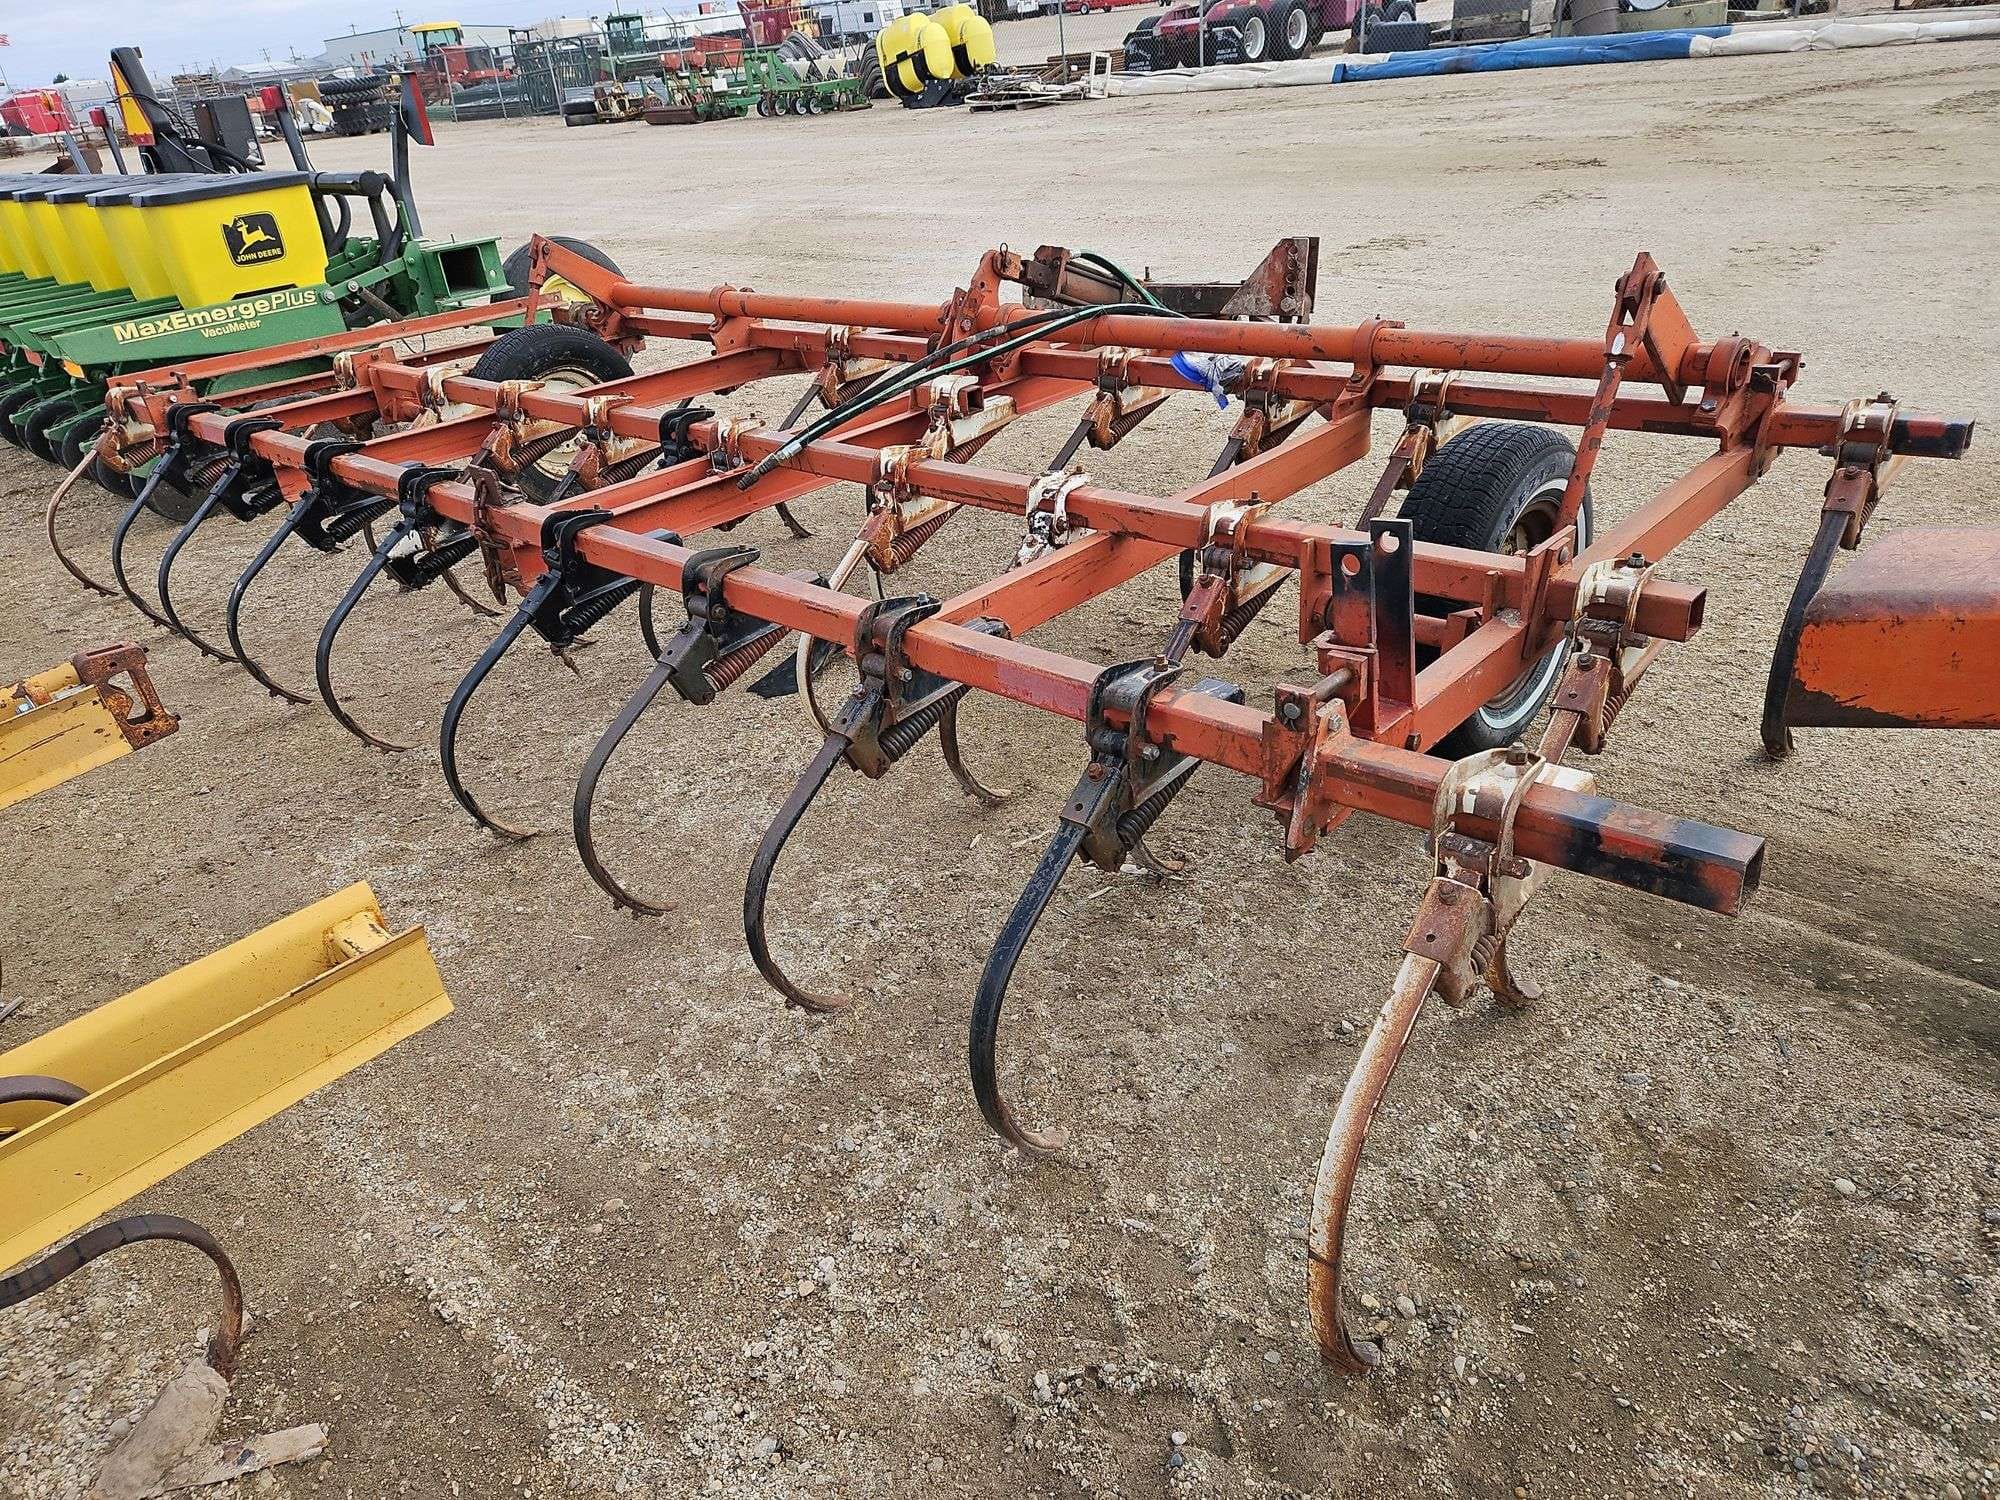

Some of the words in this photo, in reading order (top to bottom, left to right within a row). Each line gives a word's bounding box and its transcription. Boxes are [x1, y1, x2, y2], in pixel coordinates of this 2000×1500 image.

[236, 252, 257, 262] JOHN
[257, 247, 282, 258] DEERE
[201, 319, 262, 338] VacuMeter
